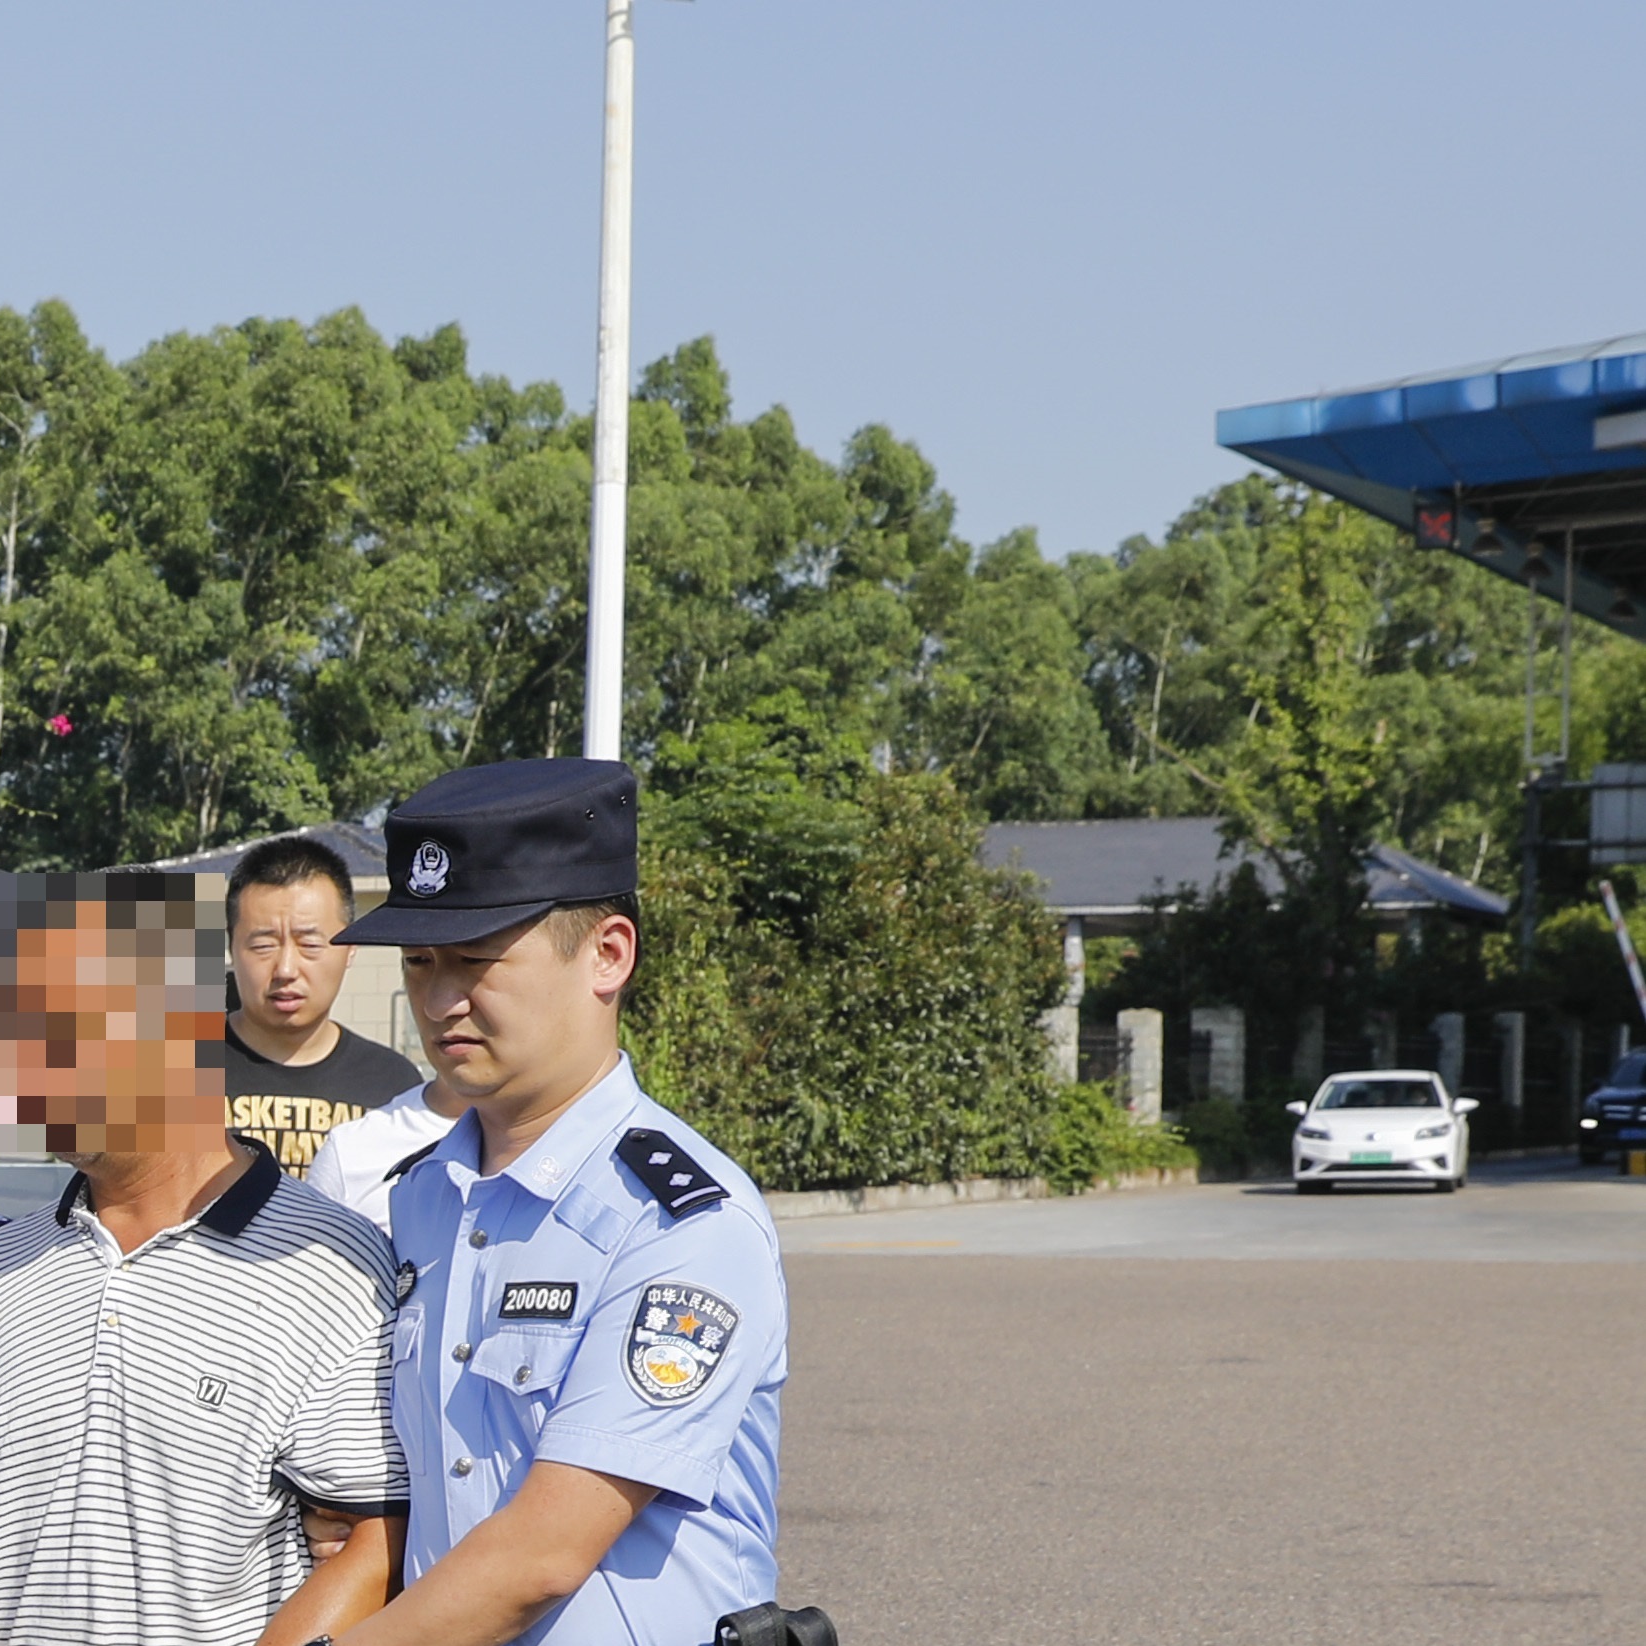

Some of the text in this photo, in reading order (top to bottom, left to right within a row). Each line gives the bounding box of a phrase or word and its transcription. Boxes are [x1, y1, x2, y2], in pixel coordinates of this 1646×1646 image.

[504, 1288, 572, 1311] 200080
[648, 1288, 737, 1331] 中华人民共和国
